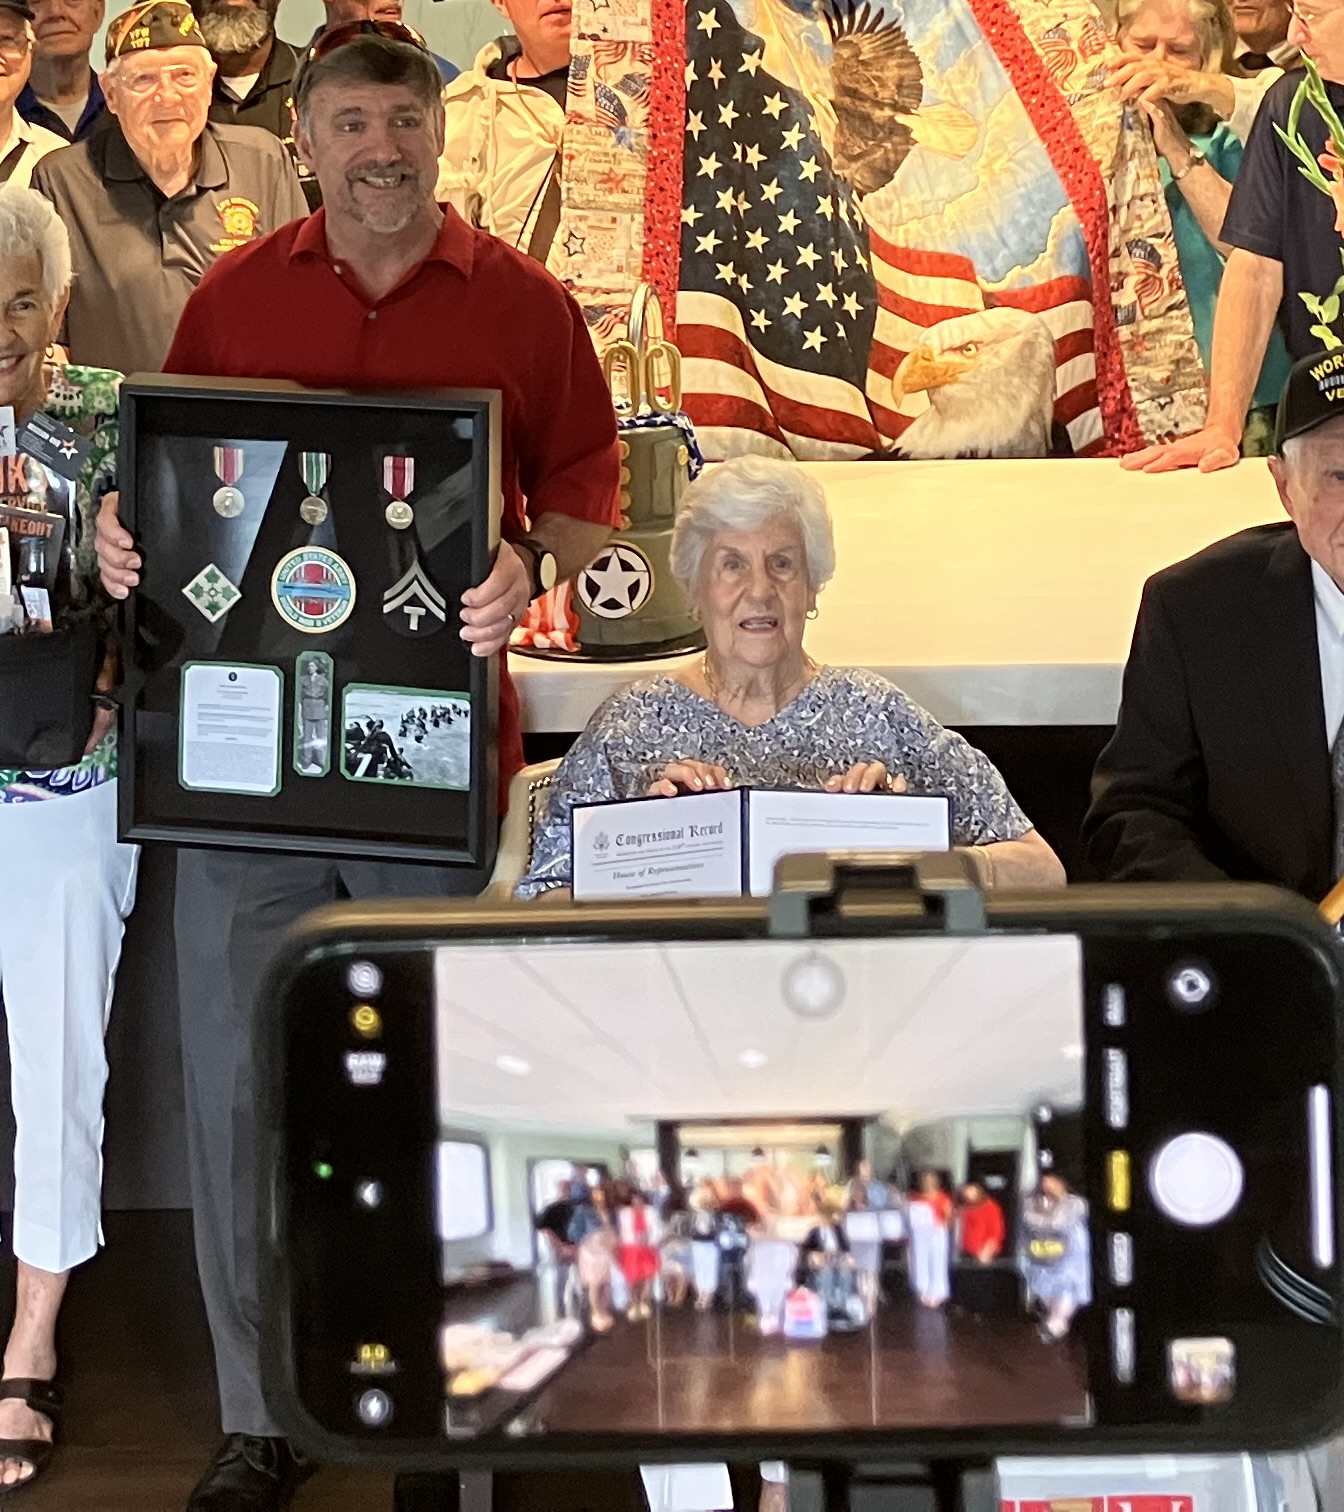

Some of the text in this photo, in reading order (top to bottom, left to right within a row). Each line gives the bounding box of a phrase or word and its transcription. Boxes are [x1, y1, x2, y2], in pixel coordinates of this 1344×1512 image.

[279, 556, 303, 581] UNITED
[302, 552, 334, 568] STATES
[615, 827, 685, 848] Congressional
[688, 821, 724, 838] Record
[612, 871, 636, 880] House
[638, 867, 646, 878] of
